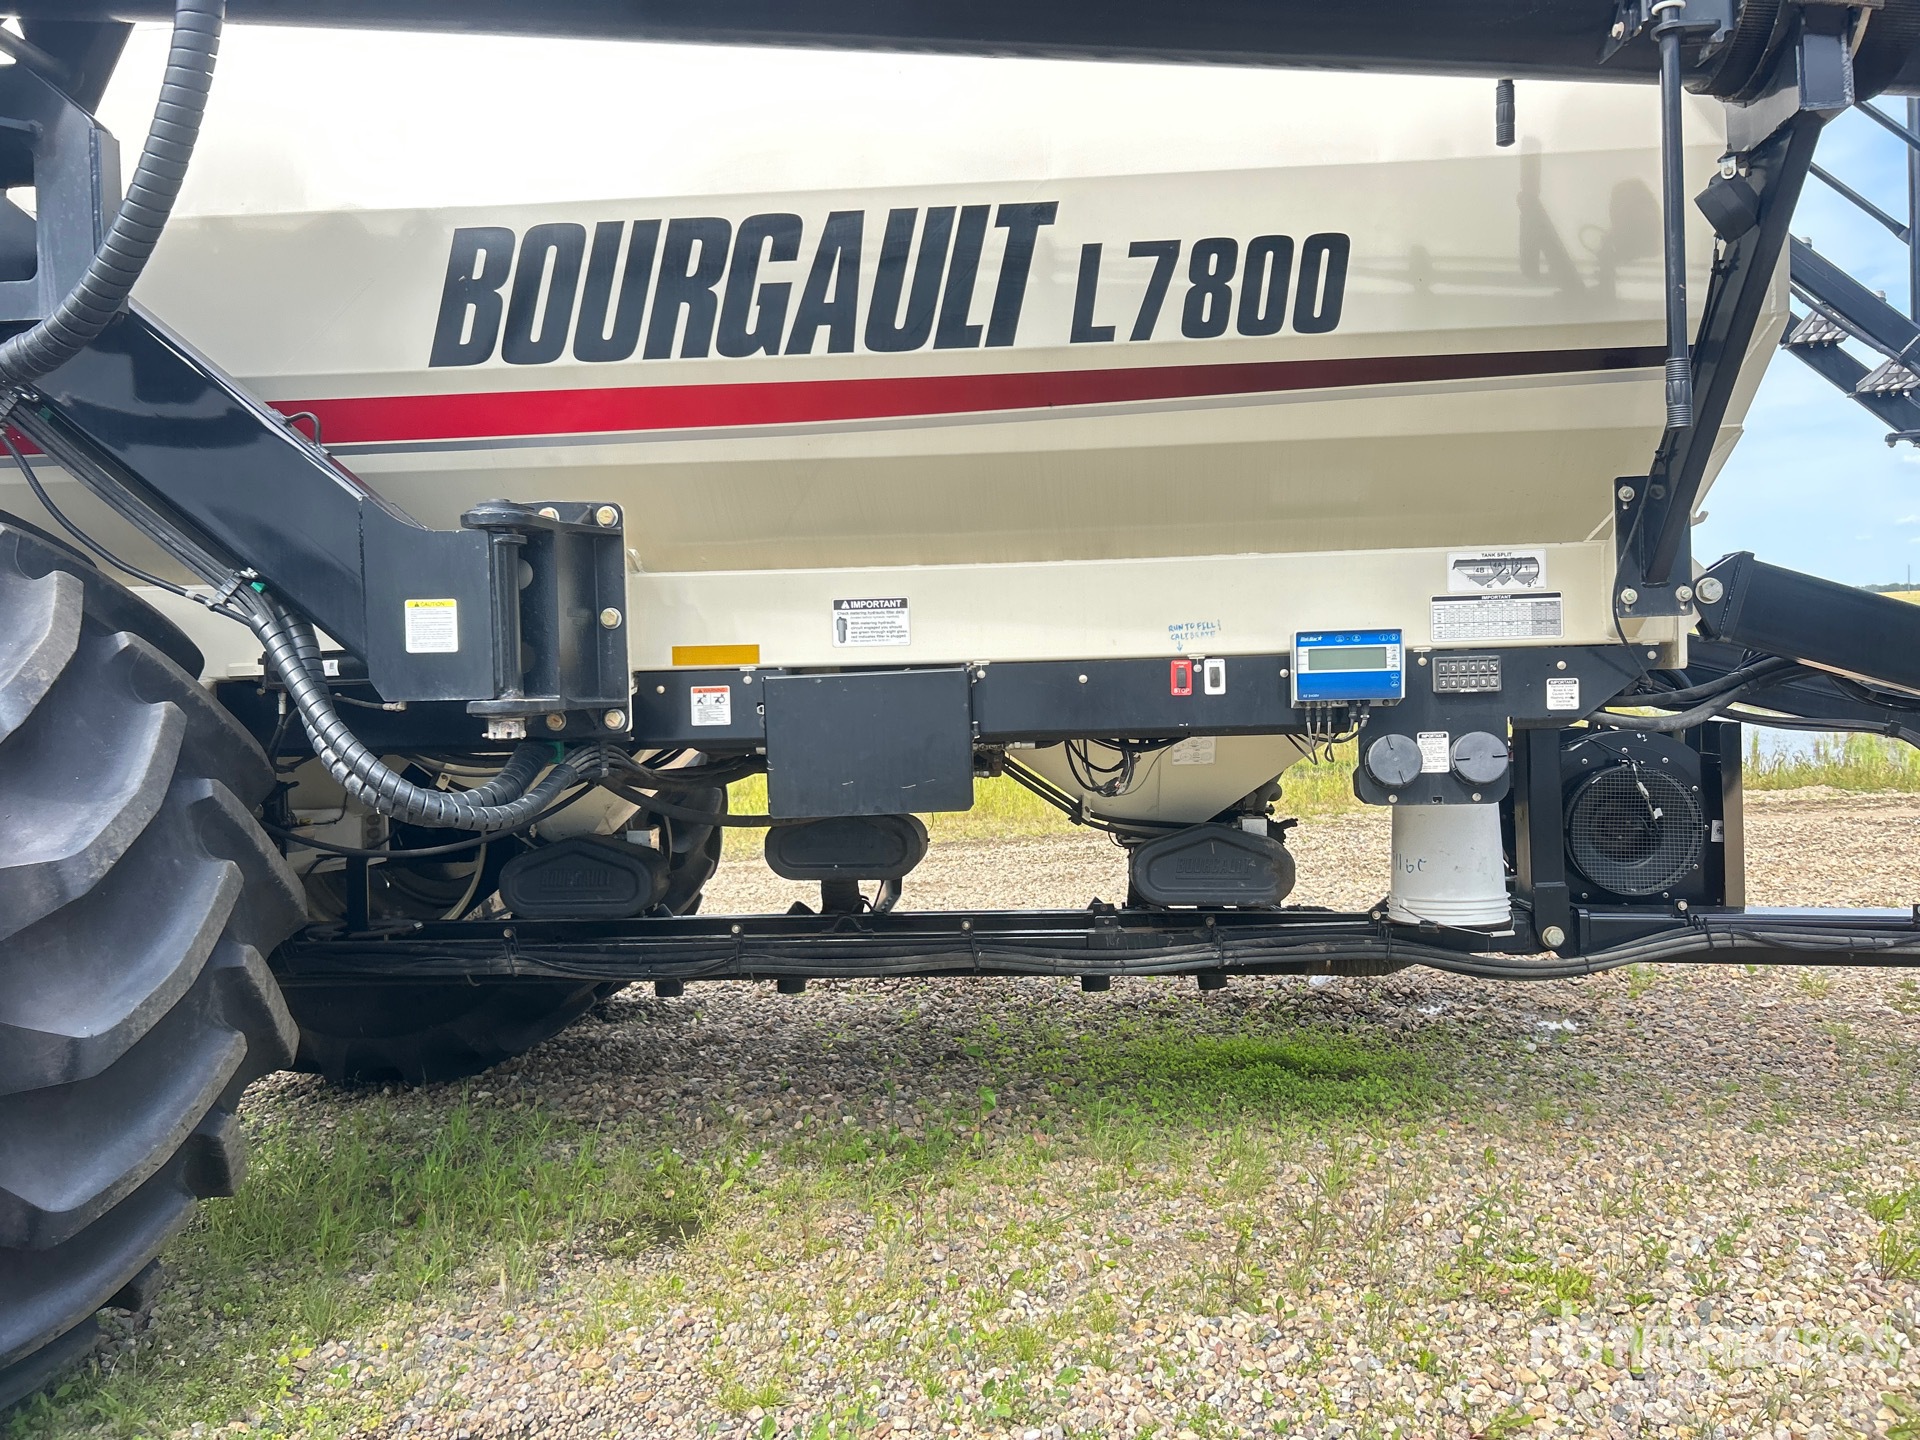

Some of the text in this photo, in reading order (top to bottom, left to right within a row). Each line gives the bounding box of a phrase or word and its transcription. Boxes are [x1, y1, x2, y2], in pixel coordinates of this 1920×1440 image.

[429, 202, 1058, 368] BOURGAULT
[850, 600, 902, 609] IMPORTANT
[1168, 622, 1216, 632] RUN TO FILL
